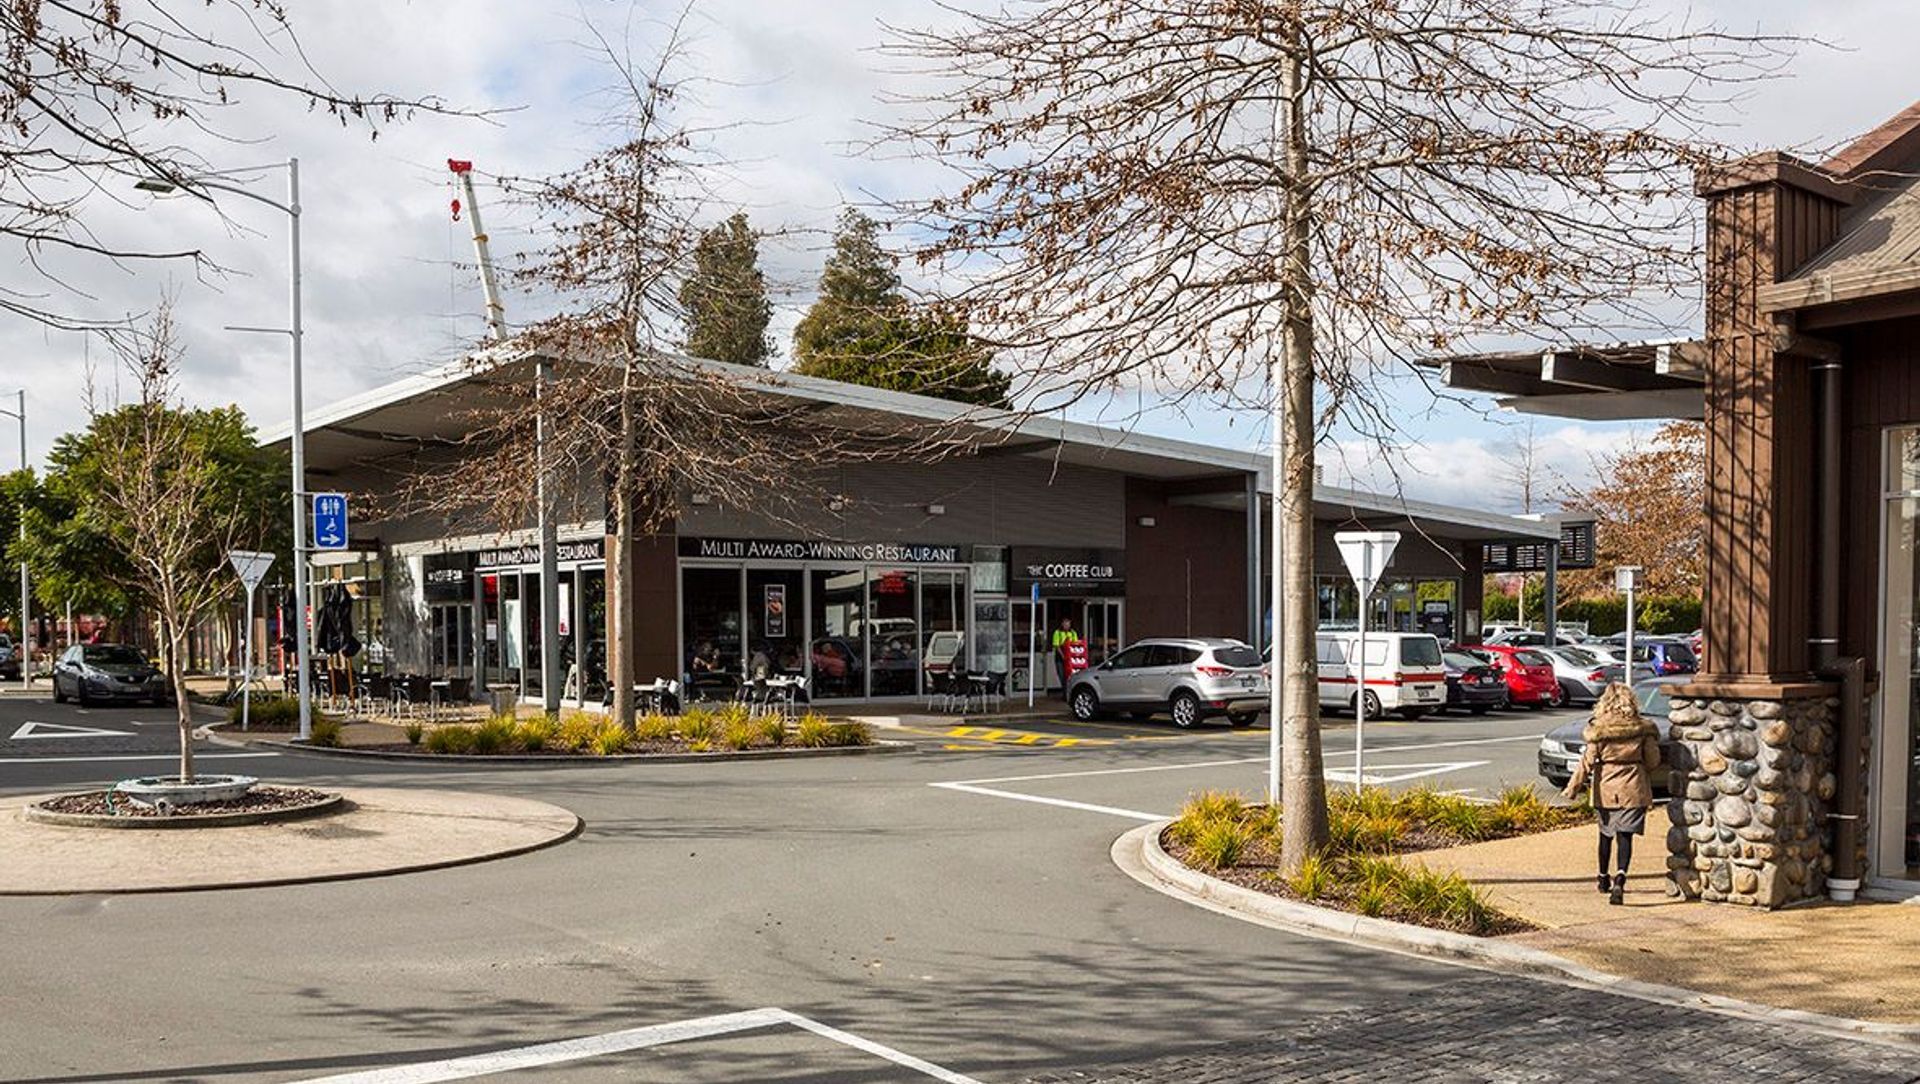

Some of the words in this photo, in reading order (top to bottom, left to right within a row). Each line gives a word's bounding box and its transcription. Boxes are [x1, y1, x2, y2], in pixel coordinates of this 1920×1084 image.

[498, 547, 541, 566] AWARD-WINN
[701, 540, 744, 557] MULTI
[747, 541, 874, 560] AWARD-WINNING
[875, 543, 957, 561] RESTAURANT
[1045, 564, 1089, 578] COFFEE
[1090, 566, 1114, 578] CLUB
